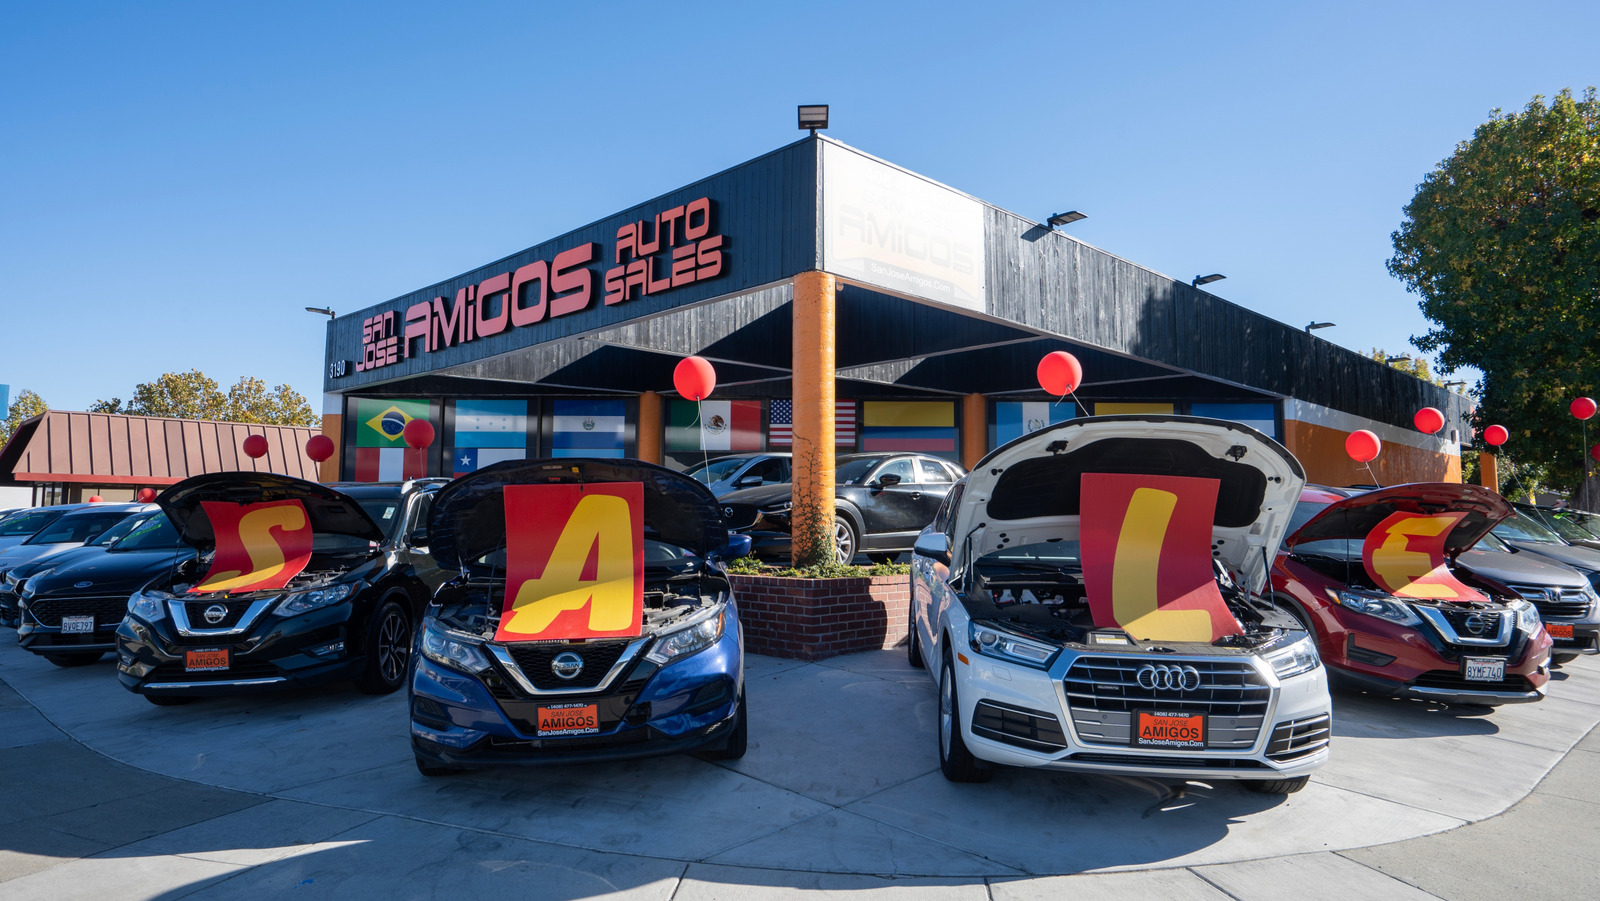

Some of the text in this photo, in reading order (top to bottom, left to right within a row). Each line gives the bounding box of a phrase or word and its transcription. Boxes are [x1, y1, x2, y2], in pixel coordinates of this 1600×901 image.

[616, 197, 710, 264] AUTO
[604, 235, 723, 306] SALES
[362, 310, 394, 345] SAN
[356, 336, 398, 372] JOSE
[329, 359, 346, 379] 3190
[197, 487, 1459, 643] S A L E
[189, 658, 226, 666] AMIGOS
[542, 716, 594, 728] AMIGOS
[1169, 719, 1189, 727] JOSE
[538, 727, 598, 736] SanJoseAmigos.Com
[1142, 726, 1198, 738] AMIGOS
[1138, 738, 1204, 747] SanJoseAmigos.Com
